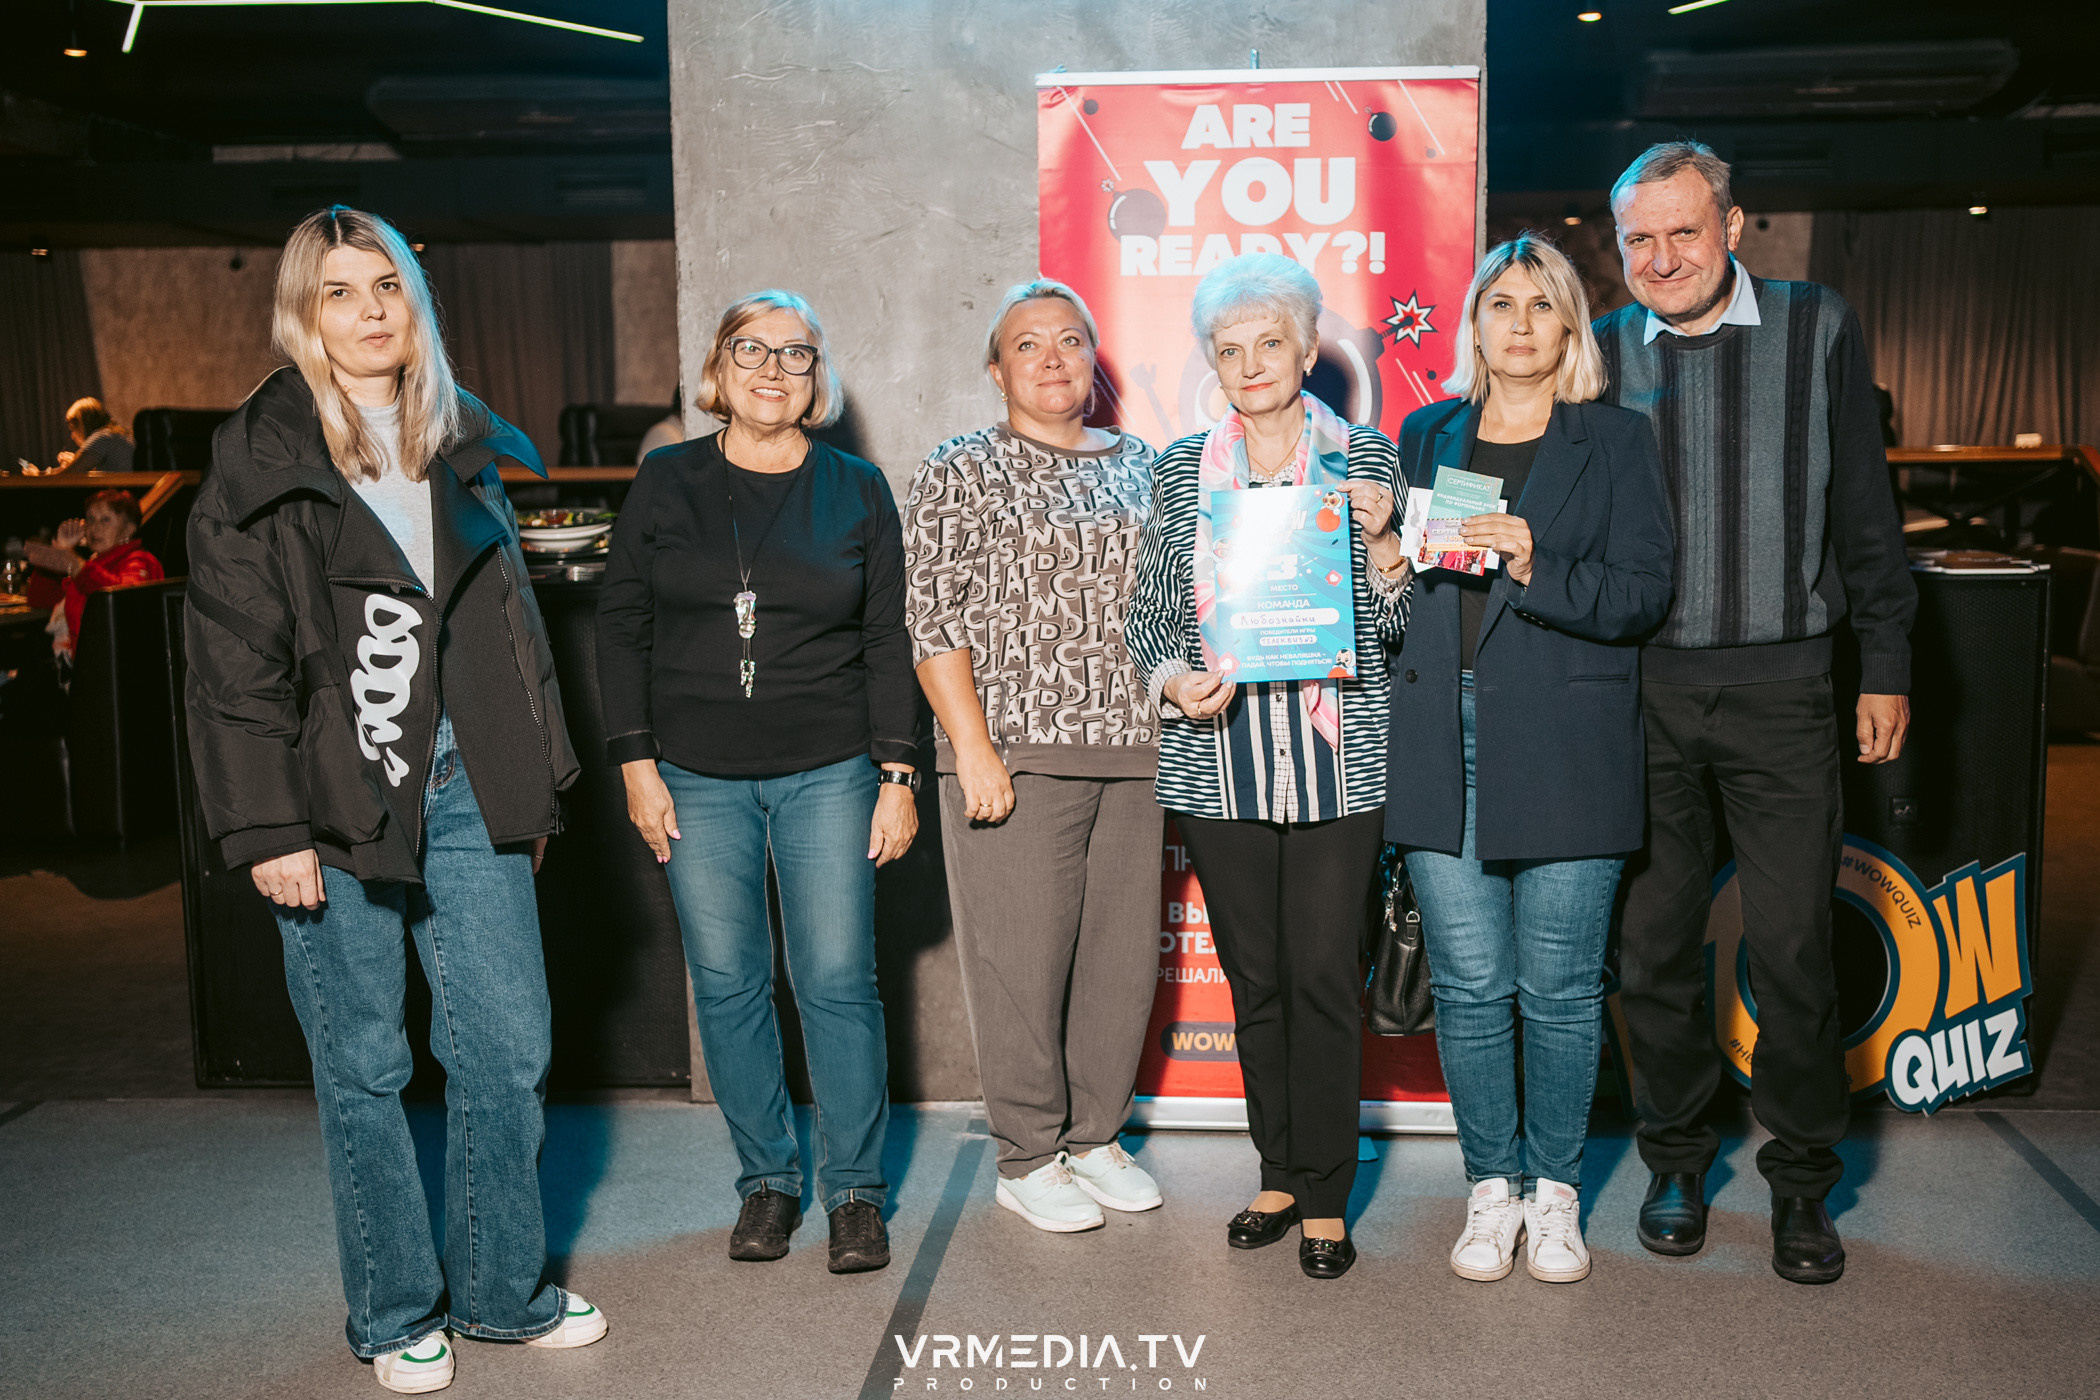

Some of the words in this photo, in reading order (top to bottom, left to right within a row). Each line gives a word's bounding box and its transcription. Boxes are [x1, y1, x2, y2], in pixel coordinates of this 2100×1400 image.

[1181, 103, 1310, 150] ARE
[1143, 156, 1356, 227] YOU
[1447, 477, 1491, 491] СЕРТИФИКАТ
[1267, 554, 1298, 581] 3
[1270, 584, 1299, 592] МЕСТО
[1257, 599, 1311, 610] КОМАНДА
[1241, 615, 1316, 626] Любознайки
[1261, 636, 1303, 645] ТЕЛЕКВИЗ
[1842, 855, 1922, 929] #WOWQUIZ
[1168, 902, 1210, 924] ВЫ
[1160, 931, 1217, 954] ОТЕ
[1171, 1031, 1236, 1051] WOW
[1891, 1007, 2025, 1105] QUIZ
